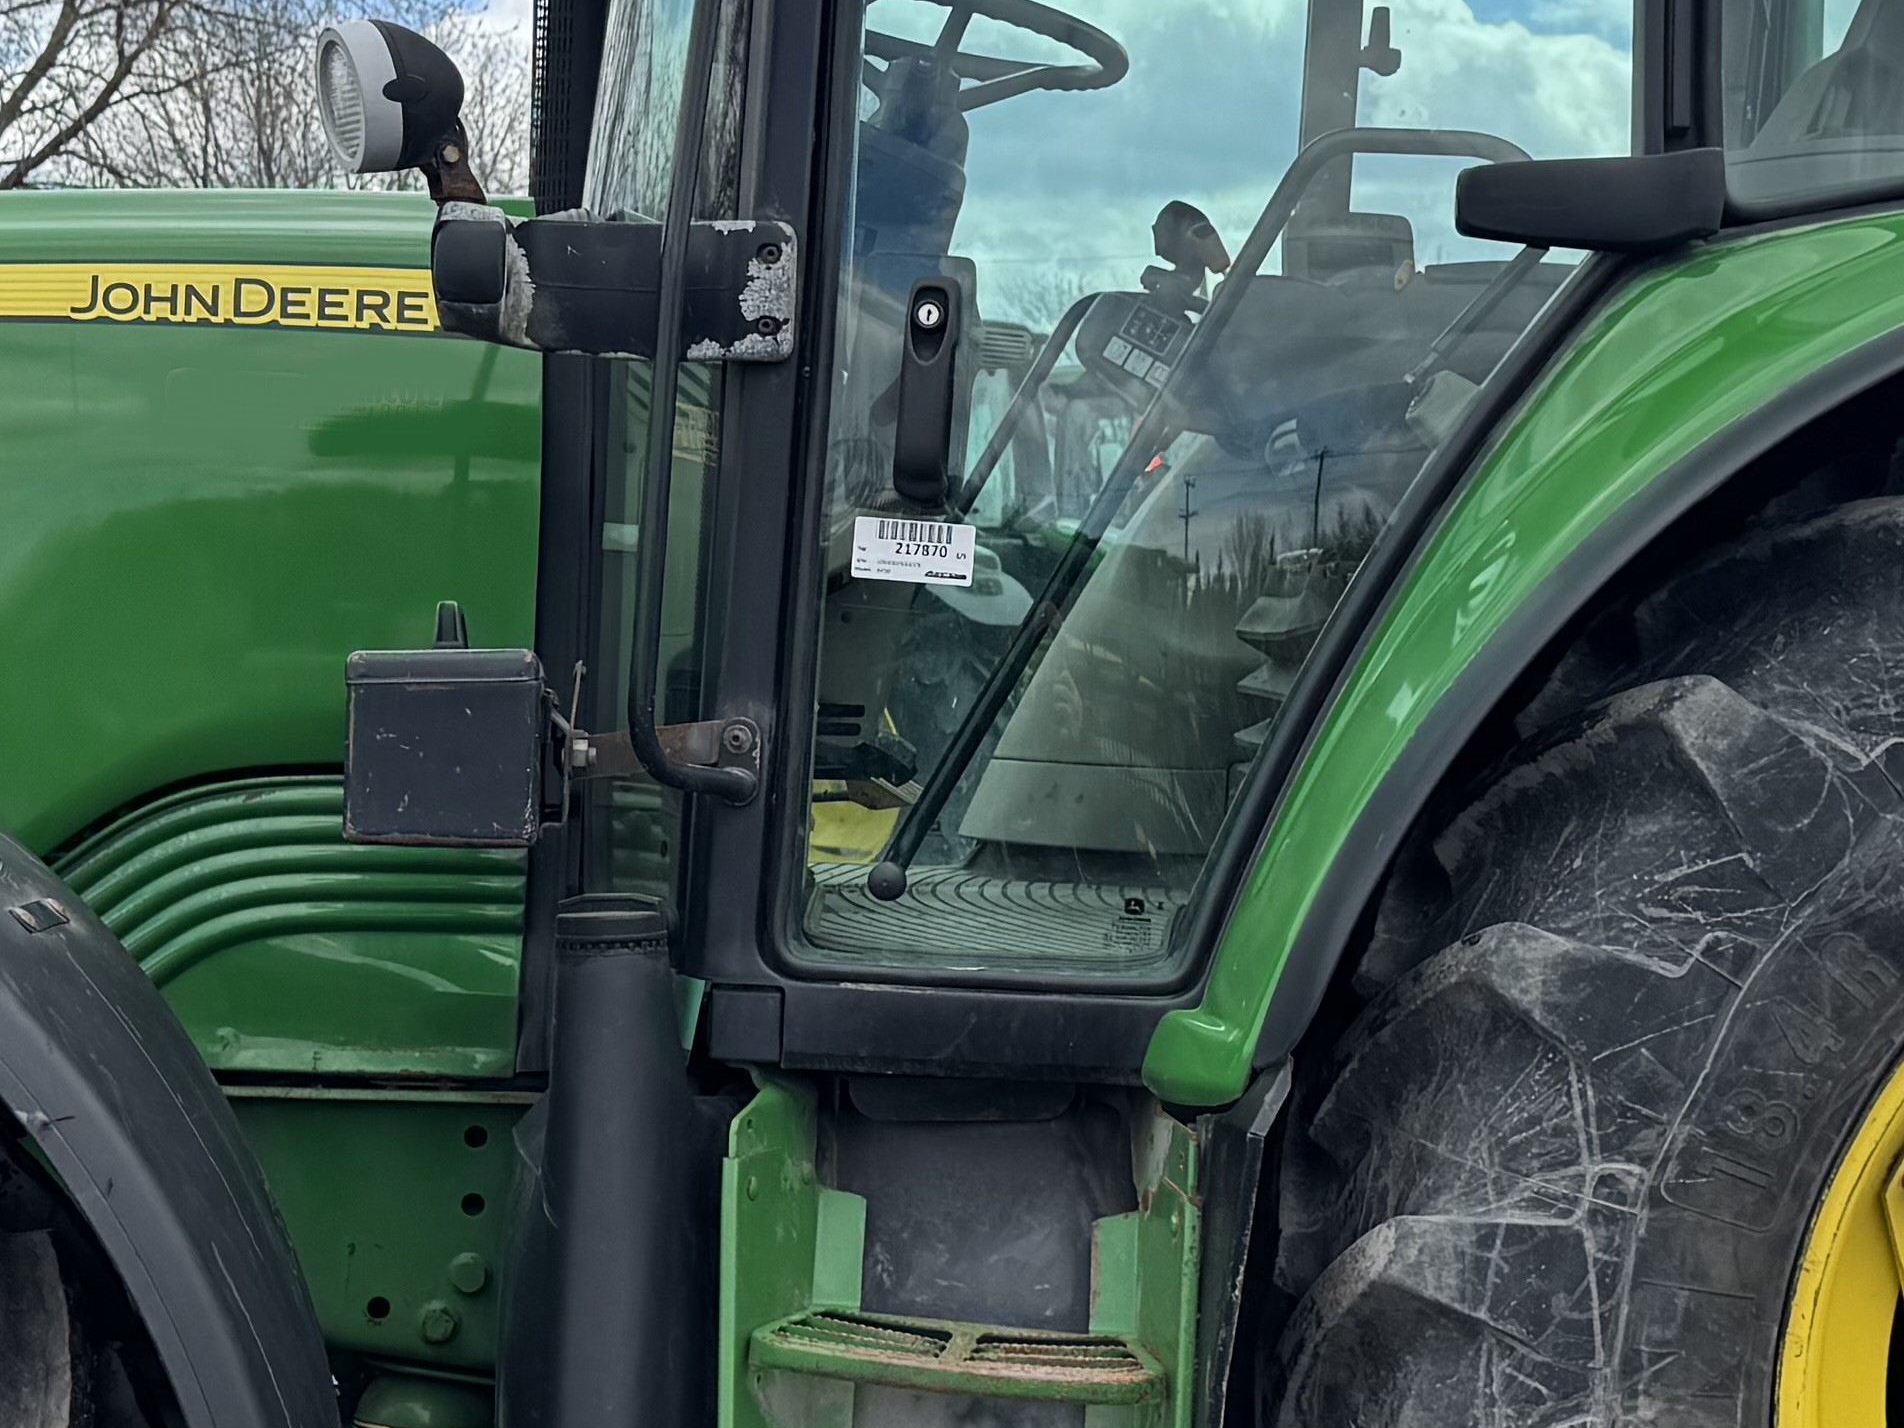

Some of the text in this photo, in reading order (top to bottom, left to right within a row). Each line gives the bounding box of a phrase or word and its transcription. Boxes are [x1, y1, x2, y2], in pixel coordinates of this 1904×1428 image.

[71, 275, 429, 324] JOHN DEERE
[895, 542, 948, 558] 217870
